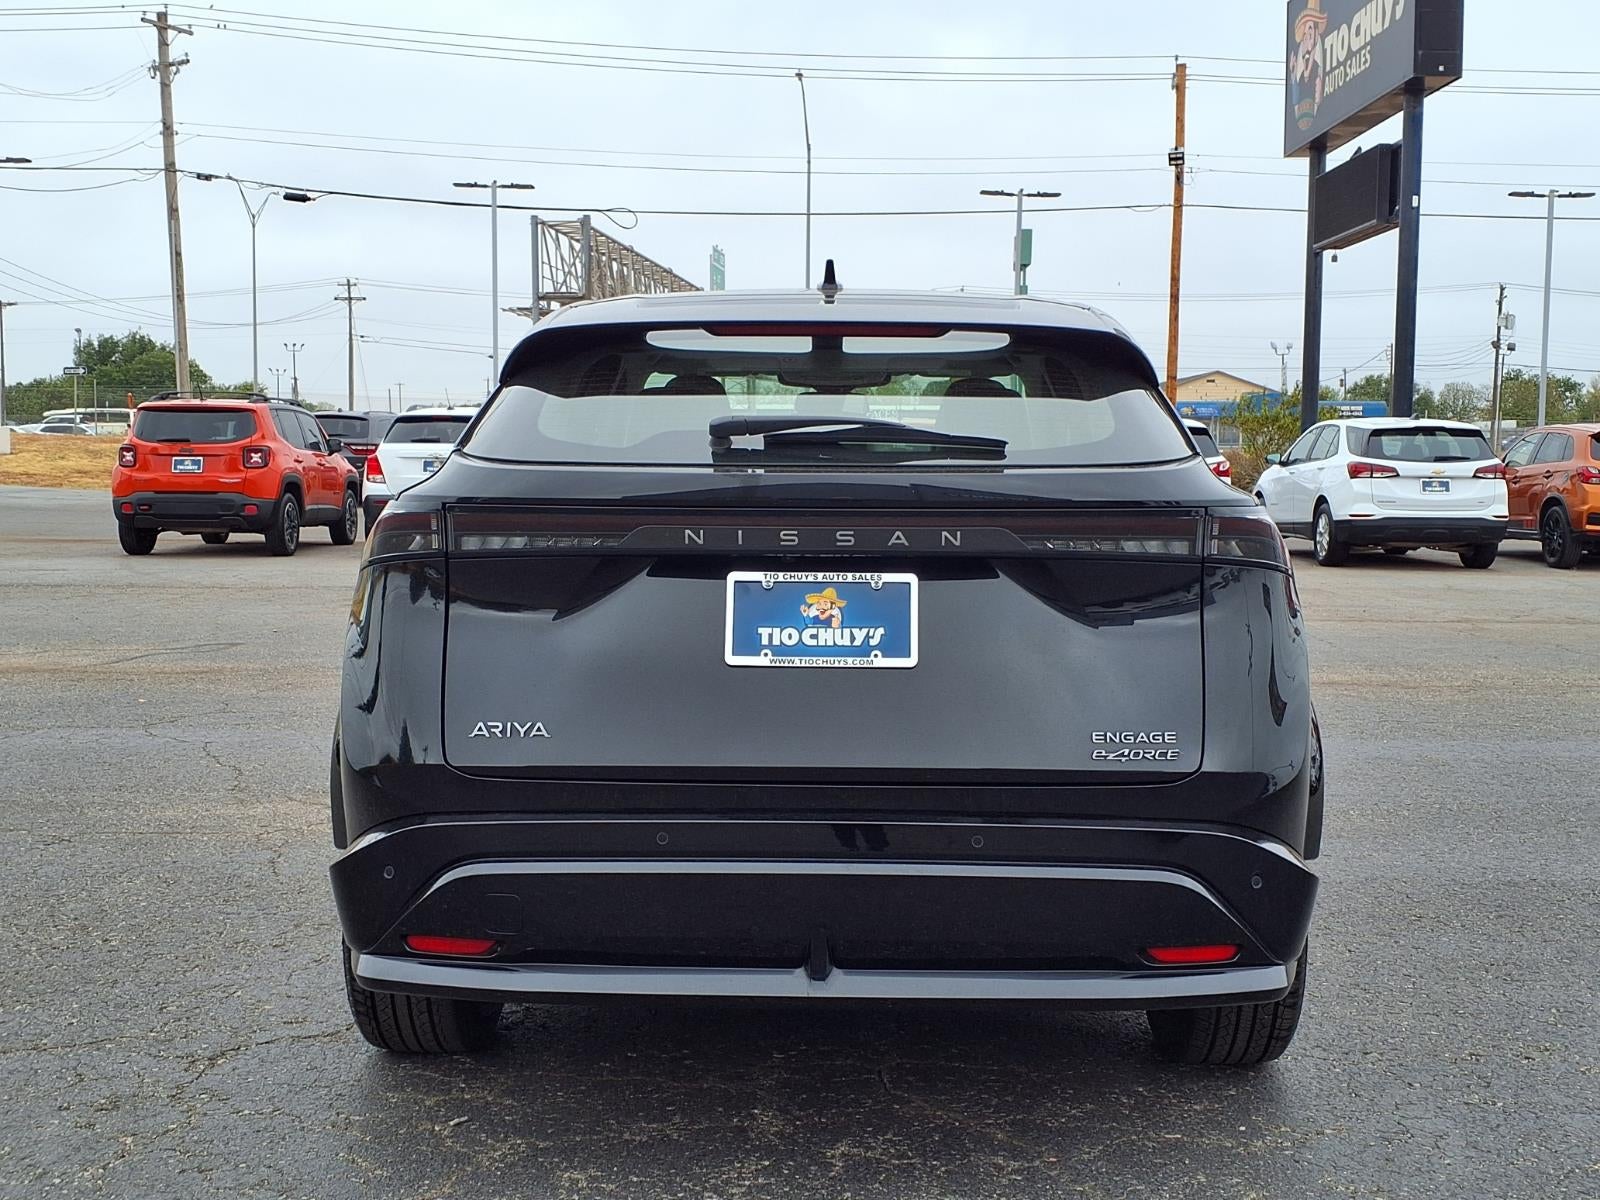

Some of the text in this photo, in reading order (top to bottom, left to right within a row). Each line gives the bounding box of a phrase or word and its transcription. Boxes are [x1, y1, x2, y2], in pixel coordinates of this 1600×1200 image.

[1324, 23, 1349, 73] TIO
[1323, 45, 1371, 97] AUTO SALES
[684, 529, 961, 546] NISSAN
[782, 573, 819, 581] CHUY'S
[822, 573, 848, 581] AUTO
[851, 573, 883, 581] SALES
[769, 658, 874, 666] WWW.TIOCHUYS.COM
[468, 721, 552, 738] ARIYA
[1092, 731, 1177, 743] ENGAGE
